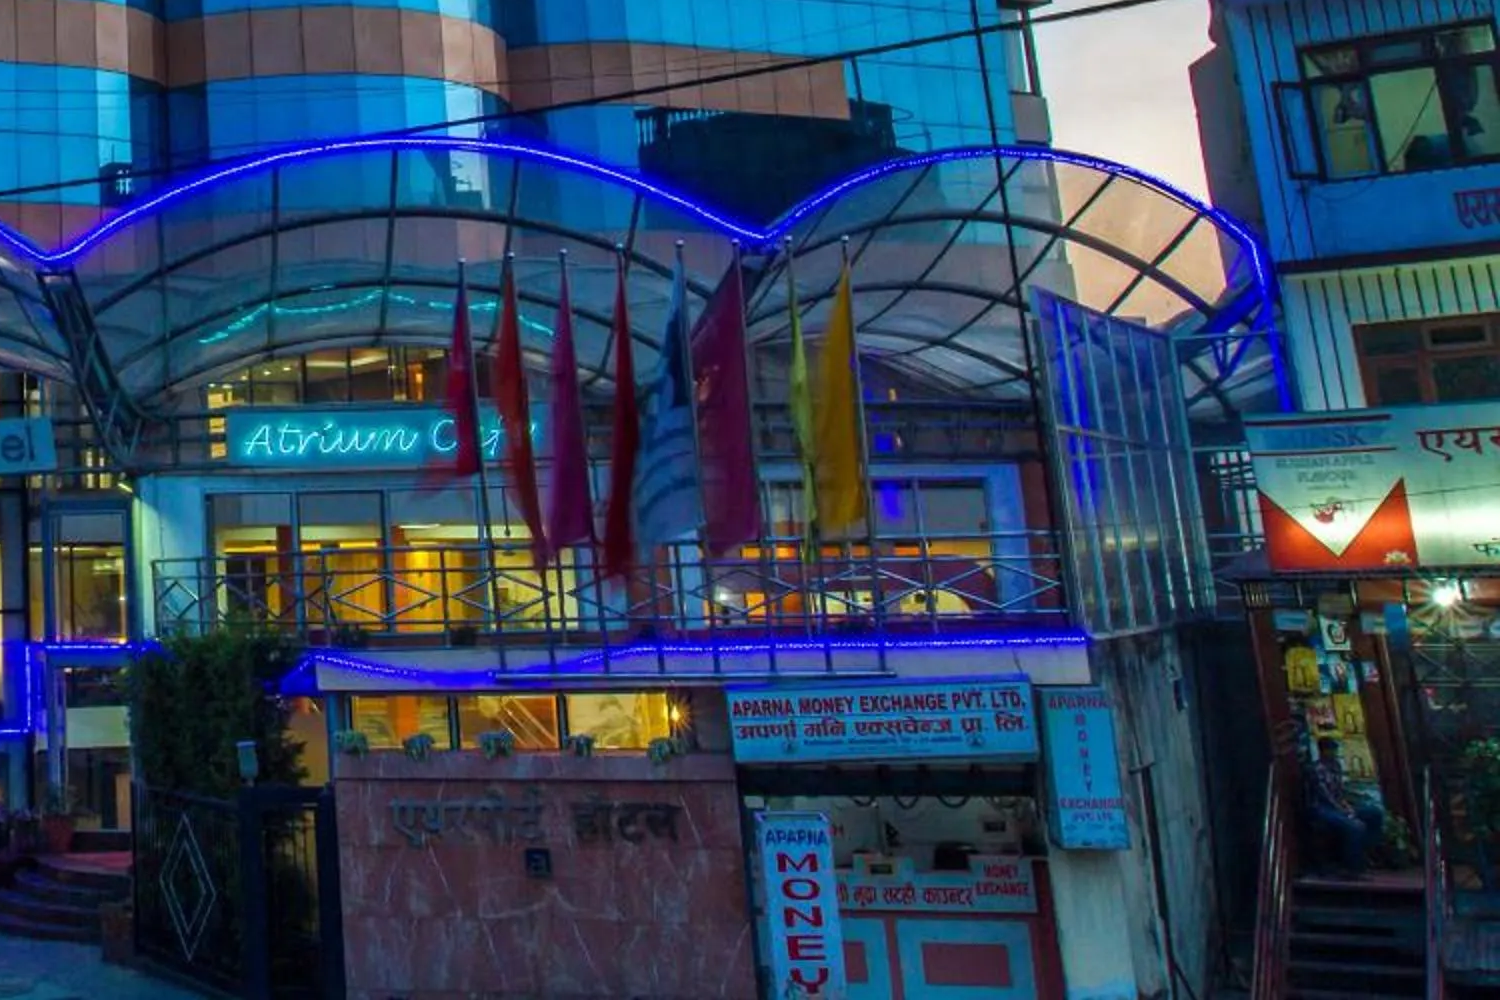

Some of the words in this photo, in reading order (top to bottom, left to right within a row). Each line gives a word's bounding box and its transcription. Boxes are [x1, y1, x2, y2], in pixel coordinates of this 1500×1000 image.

[245, 420, 419, 456] Atrium
[732, 698, 794, 717] APARNA
[799, 696, 855, 715] MONEY
[859, 693, 948, 713] EXCHANGE
[951, 692, 986, 711] PVT.
[765, 828, 828, 846] APARNA
[776, 852, 829, 994] MONEY
